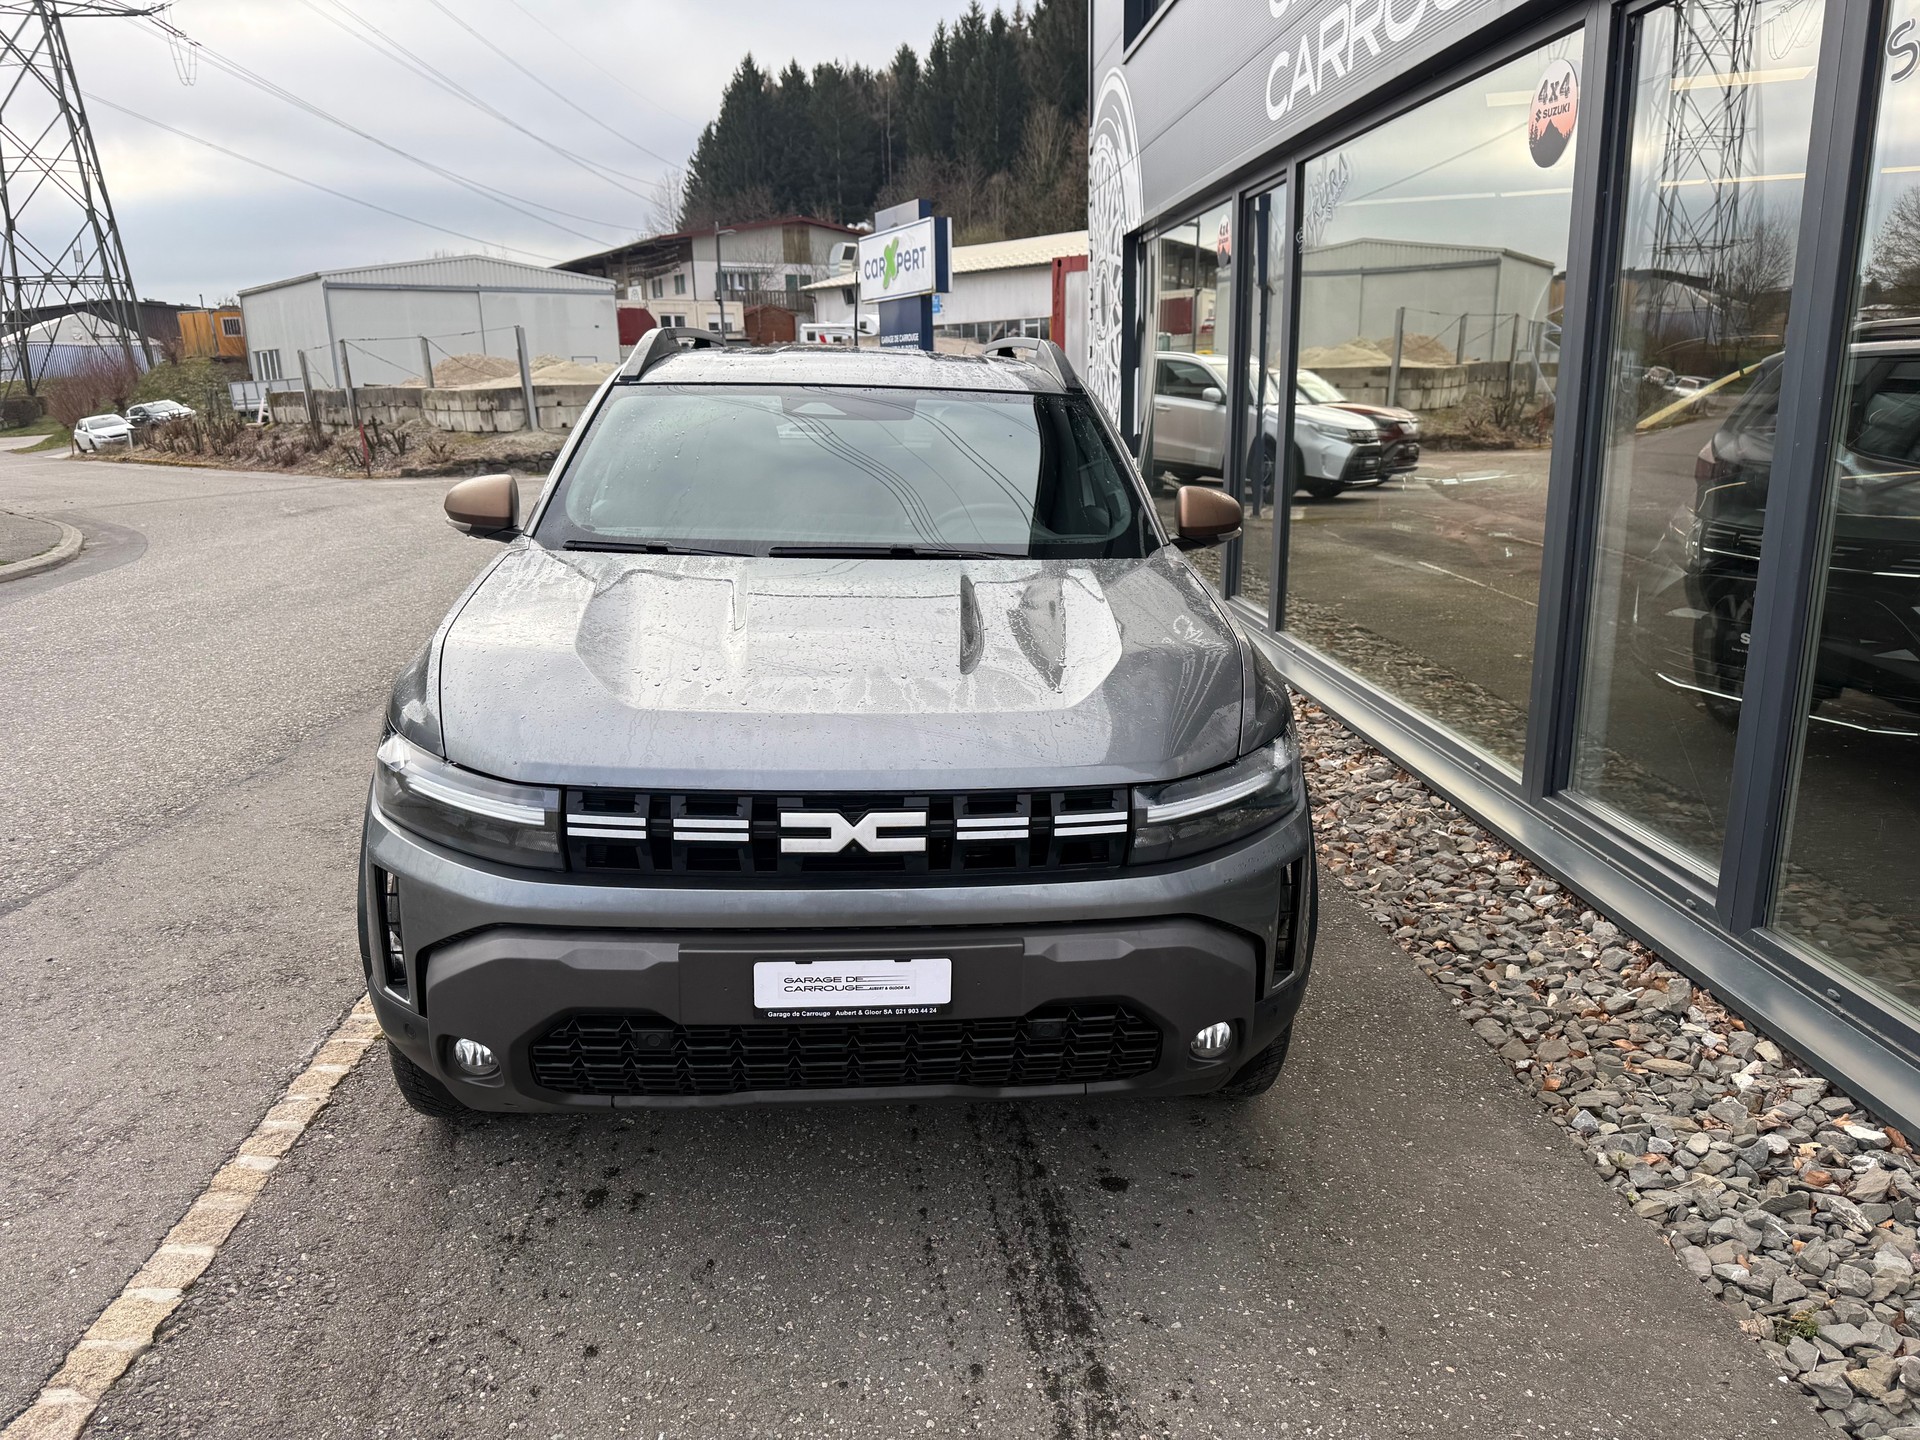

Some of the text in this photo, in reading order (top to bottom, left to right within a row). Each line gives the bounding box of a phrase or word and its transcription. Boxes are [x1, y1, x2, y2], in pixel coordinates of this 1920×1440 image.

[1542, 102, 1571, 119] SUZUKI
[783, 976, 842, 984] GARAGE
[783, 984, 864, 993] CARROUGE
[801, 1010, 831, 1018] Carrouge
